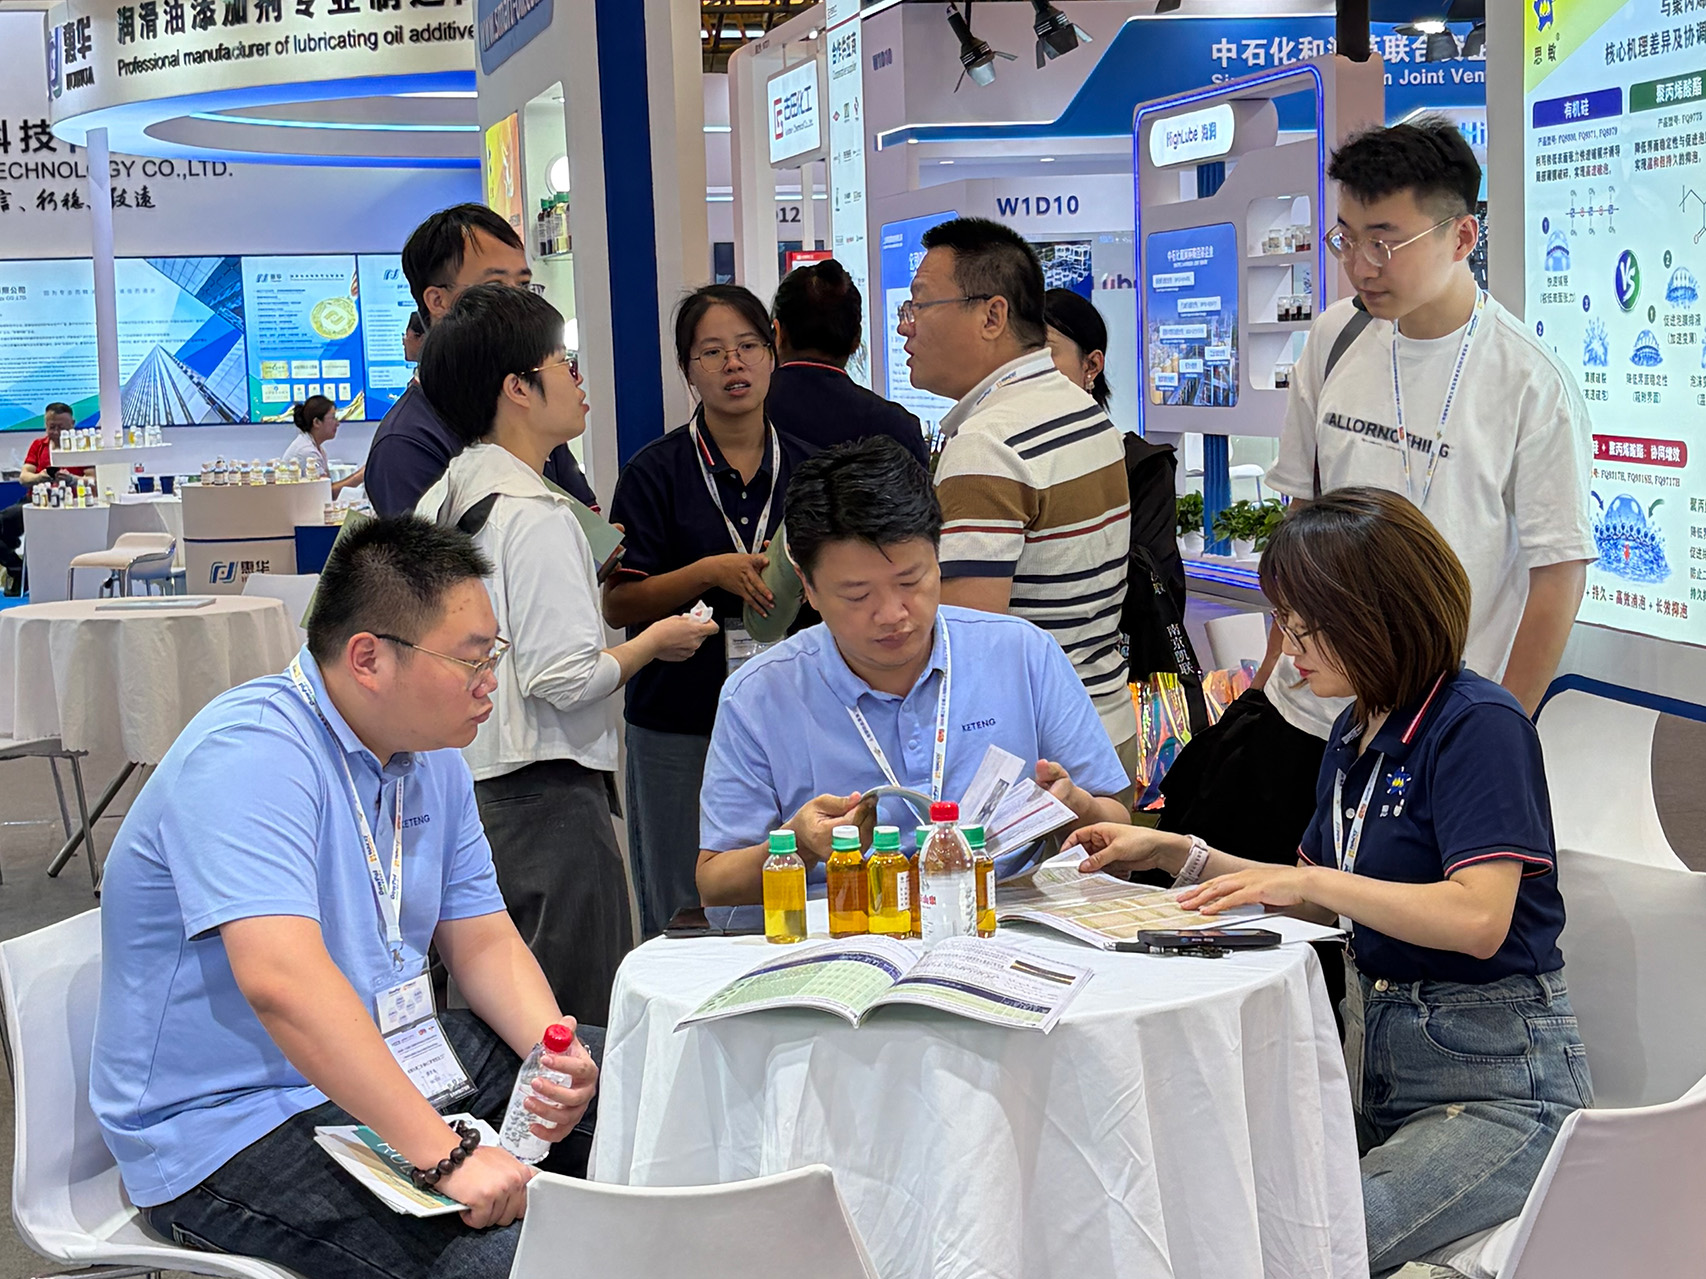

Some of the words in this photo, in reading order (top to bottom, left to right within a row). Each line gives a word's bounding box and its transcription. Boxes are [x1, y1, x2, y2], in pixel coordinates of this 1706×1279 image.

[117, 0, 465, 45] 润滑油添加剂专
[118, 50, 180, 77] Professional
[183, 42, 271, 67] manufacturer
[275, 35, 290, 55] of
[293, 29, 378, 54] lubricating
[383, 25, 404, 45] oil
[409, 20, 474, 43] additive
[1399, 68, 1445, 85] Joint
[1451, 68, 1486, 84] Ven
[1563, 99, 1590, 119] 有机硅
[1634, 131, 1706, 155] 降低界面稳定性与促进泡
[142, 158, 233, 181] CO.,LTD.
[777, 206, 801, 223] 12
[996, 195, 1080, 217] W1D10
